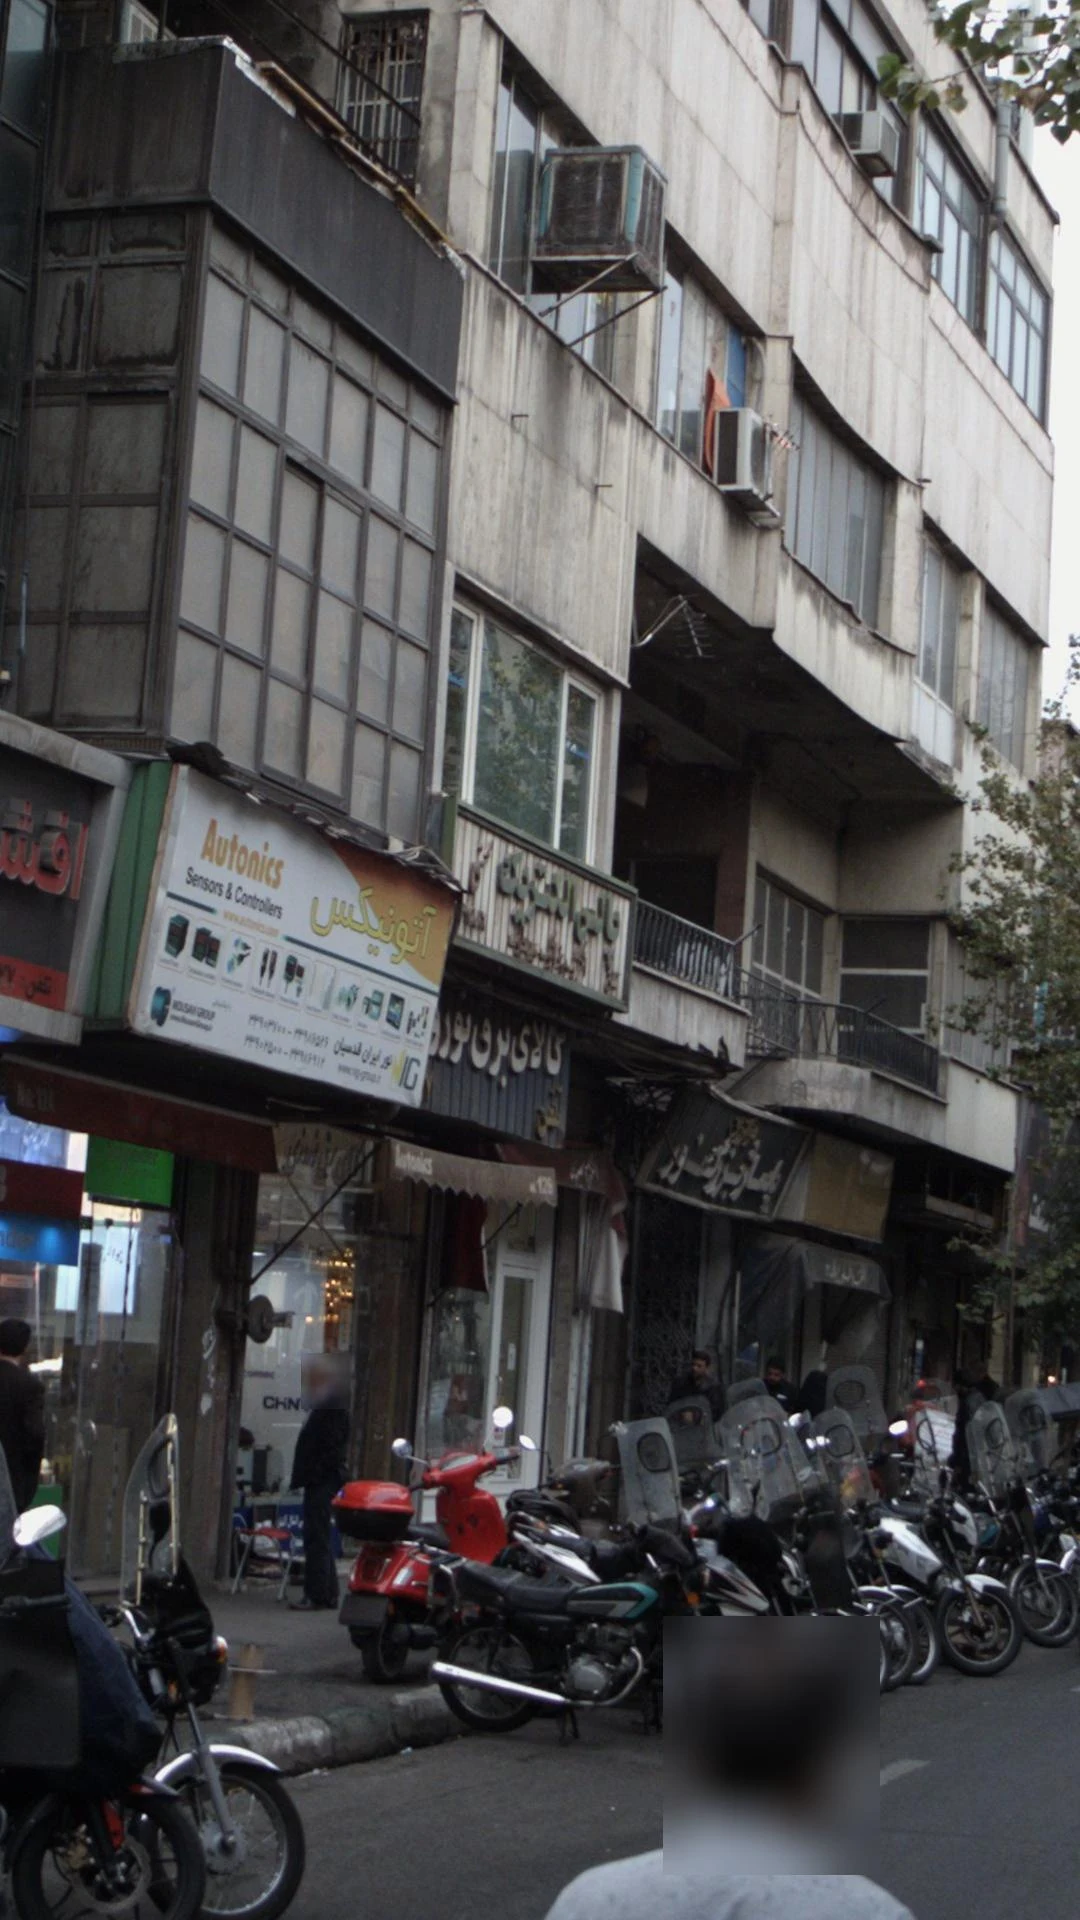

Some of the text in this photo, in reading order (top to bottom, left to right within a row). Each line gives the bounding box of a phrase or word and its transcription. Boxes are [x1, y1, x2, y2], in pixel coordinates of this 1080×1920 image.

[201, 818, 285, 889] Autonics
[185, 866, 283, 919] Sensors & Controllers
[311, 887, 437, 964] آتونیکس
